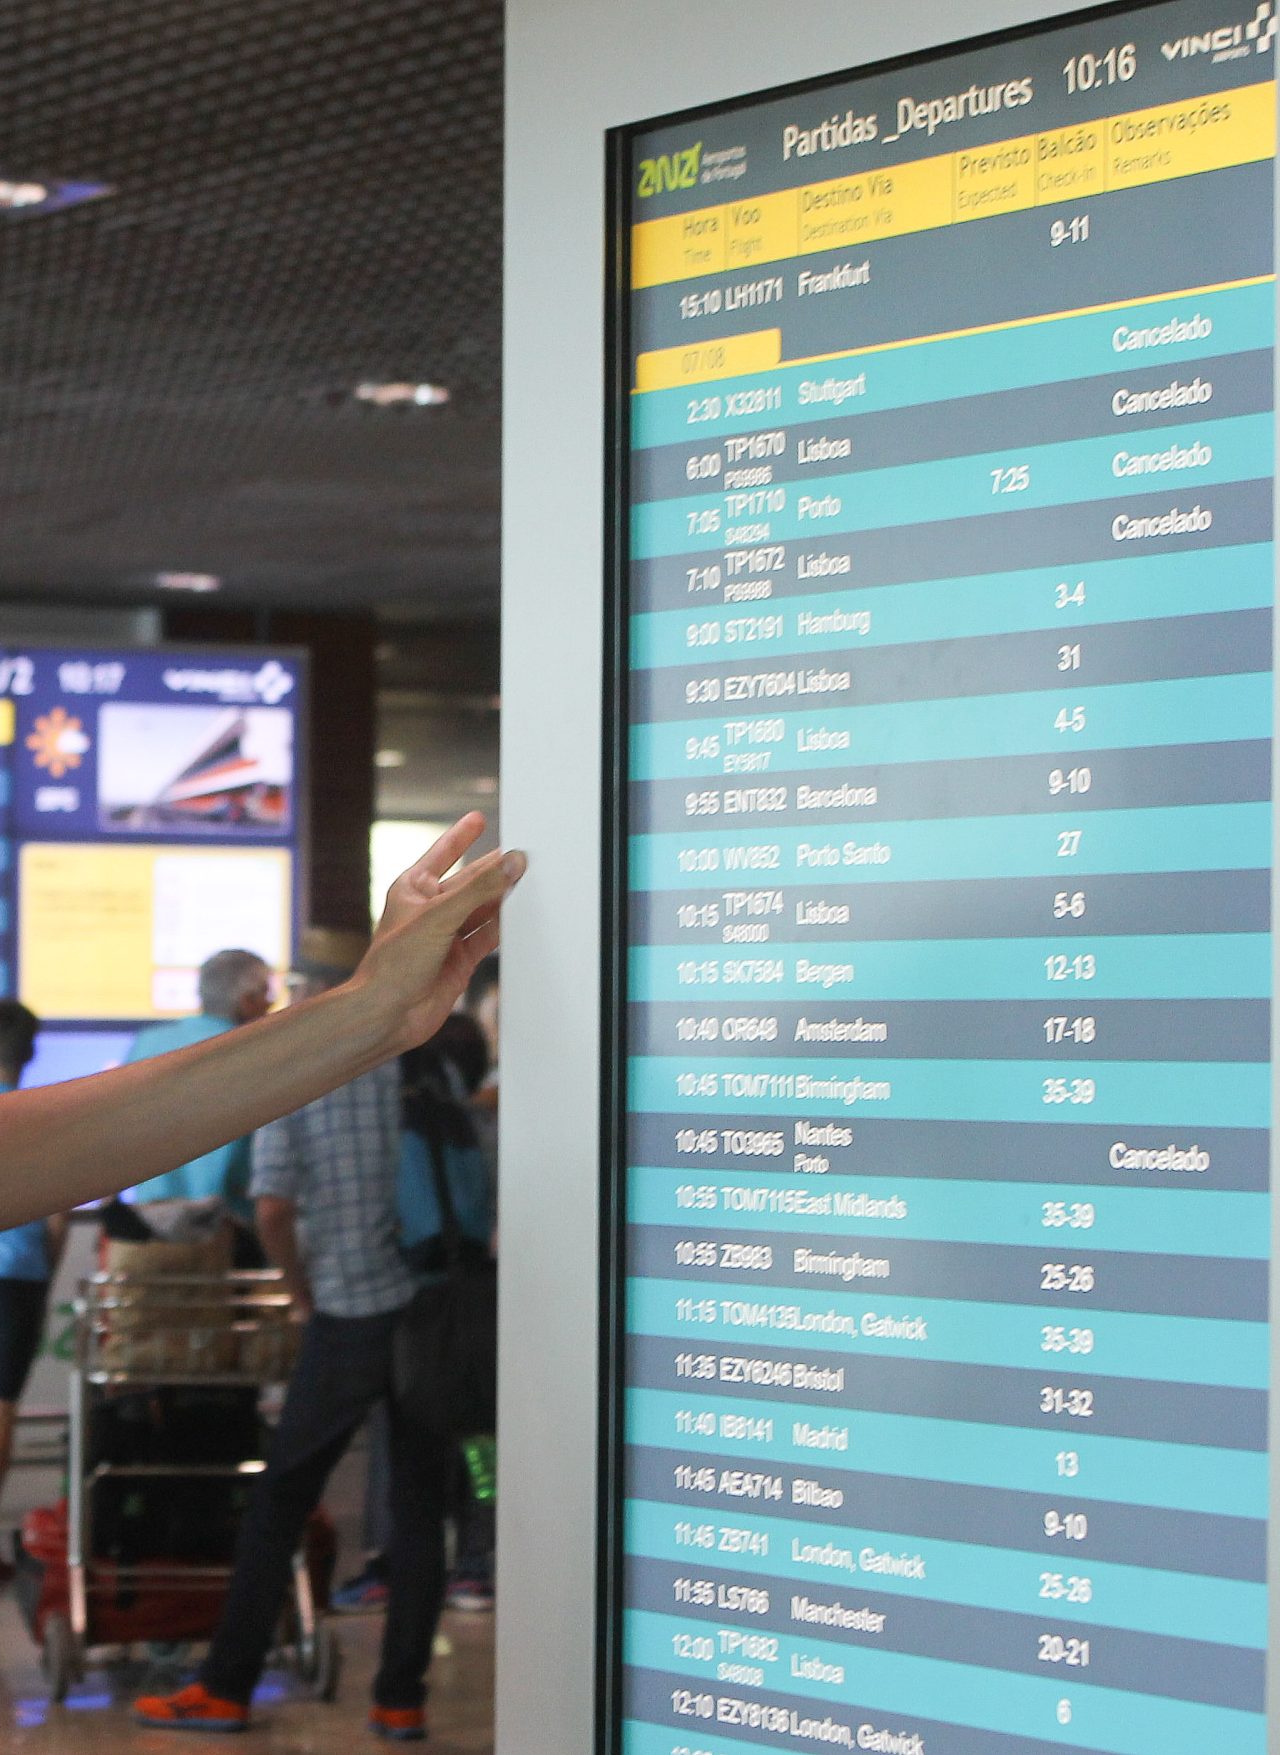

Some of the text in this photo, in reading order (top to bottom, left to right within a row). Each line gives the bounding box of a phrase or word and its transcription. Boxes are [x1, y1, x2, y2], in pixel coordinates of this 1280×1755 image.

[1160, 24, 1242, 61] VINCI
[783, 107, 878, 161] Partidas
[1063, 42, 1137, 95] 10:16
[682, 101, 1231, 240] Hora Voo Destino Via Previsto Balcão Observações
[684, 248, 711, 264] Time
[803, 215, 869, 242] Destination
[873, 208, 893, 226] Via
[958, 181, 1017, 210] Expected
[1039, 165, 1097, 192] Check-in
[1114, 150, 1171, 176] Remarks
[679, 214, 1089, 319] 15:10 LH1171 Frankfurt 9-11
[686, 396, 721, 425] 2:30
[798, 372, 866, 406] Stuttgart
[1112, 312, 1213, 352] Cancelado
[686, 377, 1213, 481] 6:00 TP1670 Lisboa Cancelado
[687, 441, 1213, 536] 7:05 TP1710 Porto 7:25 Cancelado
[687, 505, 1213, 593] 7:10 TP1672 Lisboa Cancelado
[687, 581, 1086, 647] 9:00 ST2191 Hamburg 3-4
[686, 644, 1081, 704] 9:30 EZY7604 Lisboa 31
[686, 735, 720, 760] 9:45
[797, 727, 850, 752] Lisboa
[1054, 706, 1086, 733] 4-5
[685, 791, 719, 816] 9:55
[796, 783, 878, 810] Barcelona
[1049, 767, 1091, 795] 9-10
[677, 848, 719, 872] 10:00
[797, 843, 840, 867] Porto
[842, 841, 891, 866] Santo
[1057, 830, 1082, 857] 27
[677, 890, 1086, 928] 10:15 TP1674 Lisboa 5-6
[677, 960, 719, 985] 10:15
[796, 958, 854, 989] Bergen
[1044, 954, 1096, 981] 12-13
[676, 1017, 719, 1041] 10:40
[794, 1017, 888, 1043] Amsterdam
[1043, 1015, 1096, 1044] 17-18
[676, 1072, 718, 1097] 10:45
[795, 1074, 891, 1106] Birmingham
[1042, 1078, 1096, 1104] 35-39
[675, 1128, 719, 1153] 10:45
[794, 1119, 853, 1147] Nantes
[1109, 1141, 1210, 1172] Cancelado
[794, 1152, 830, 1174] Porto
[675, 1184, 718, 1209] 10:55
[795, 1189, 833, 1216] East
[833, 1191, 908, 1220] Midlands
[1041, 1201, 1095, 1229] 35-39
[674, 1240, 717, 1267] 10:55
[794, 1248, 890, 1282] Birmingham
[1040, 1262, 1095, 1293] 25-26
[675, 1298, 717, 1324] 11:15
[794, 1306, 858, 1339] London,
[860, 1311, 928, 1341] Gatwick
[1040, 1325, 1094, 1355] 35-39
[674, 1352, 717, 1380] 11:35
[792, 1363, 845, 1392] Bristol
[1040, 1386, 1094, 1418] 31-32
[675, 1410, 716, 1436] 11:40
[792, 1421, 848, 1451] Madrid
[1055, 1450, 1079, 1478] 13
[674, 1464, 1088, 1541] 11:45 AEA714 Bilbao 9-10
[674, 1521, 715, 1549] 11:45
[791, 1536, 856, 1573] London,
[859, 1547, 927, 1580] Gatwick
[1039, 1571, 1092, 1604] 25-26
[673, 1577, 1090, 1667] 11:55 LS766 Manchester 20-21
[672, 1633, 714, 1662] 12:00
[790, 1652, 845, 1685] Lisboa
[1056, 1697, 1072, 1725] 6
[671, 1689, 714, 1719] 12:10
[790, 1710, 855, 1750] London,
[857, 1723, 925, 1755] Gatwick
